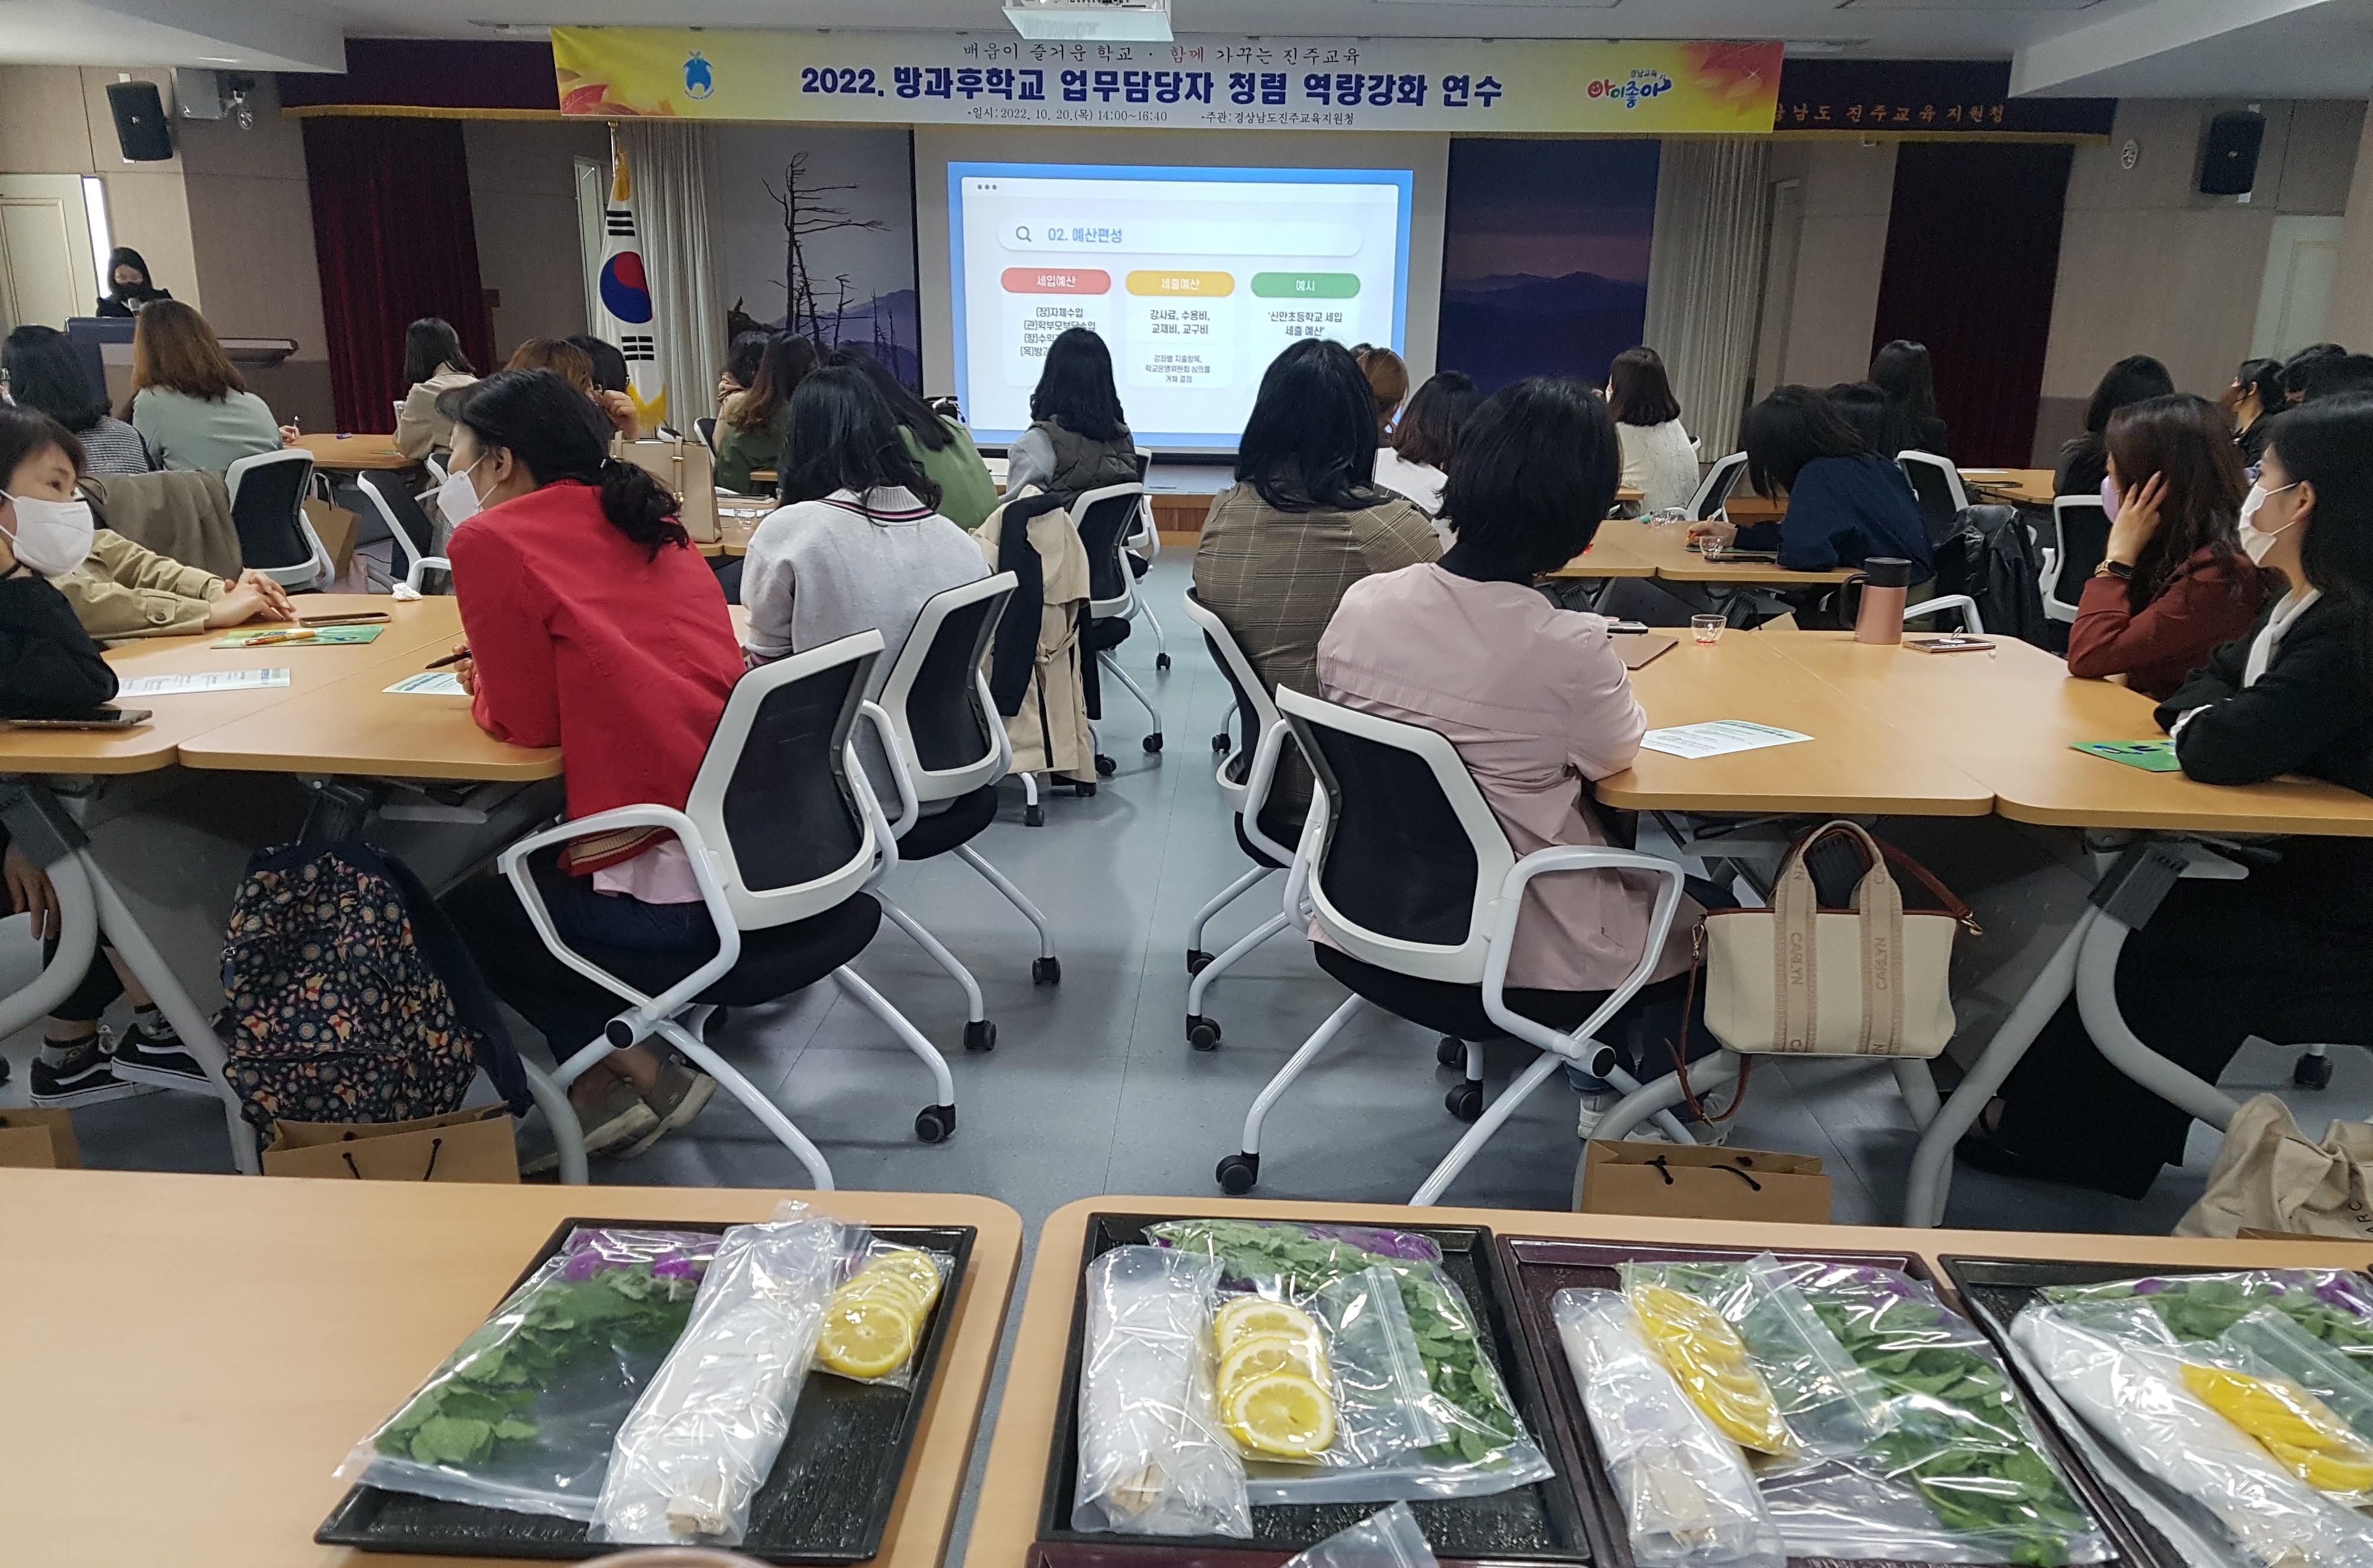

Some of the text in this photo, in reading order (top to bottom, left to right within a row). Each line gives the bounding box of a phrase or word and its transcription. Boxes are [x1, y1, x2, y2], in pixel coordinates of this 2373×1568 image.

[964, 43, 1360, 65] 배움이 즐거운 학교 함께 가꾸는 진주교육
[801, 67, 1503, 108] 2022. 방과후학교 업무담당자 청렴 역량강화 연수
[1587, 79, 1672, 109] 아이좋아
[1048, 227, 1123, 244] 02. 예산편성
[1036, 274, 1077, 288] 세입예산
[1160, 277, 1201, 291] 세출예산
[1295, 279, 1315, 291] 예시
[1149, 309, 1210, 322] 강사료, 수용비,
[1325, 312, 1343, 323] 세입
[1151, 323, 1209, 336] 교재비, 교구비
[1790, 932, 1804, 985] CARLYN
[1874, 937, 1888, 991] CARLYN
